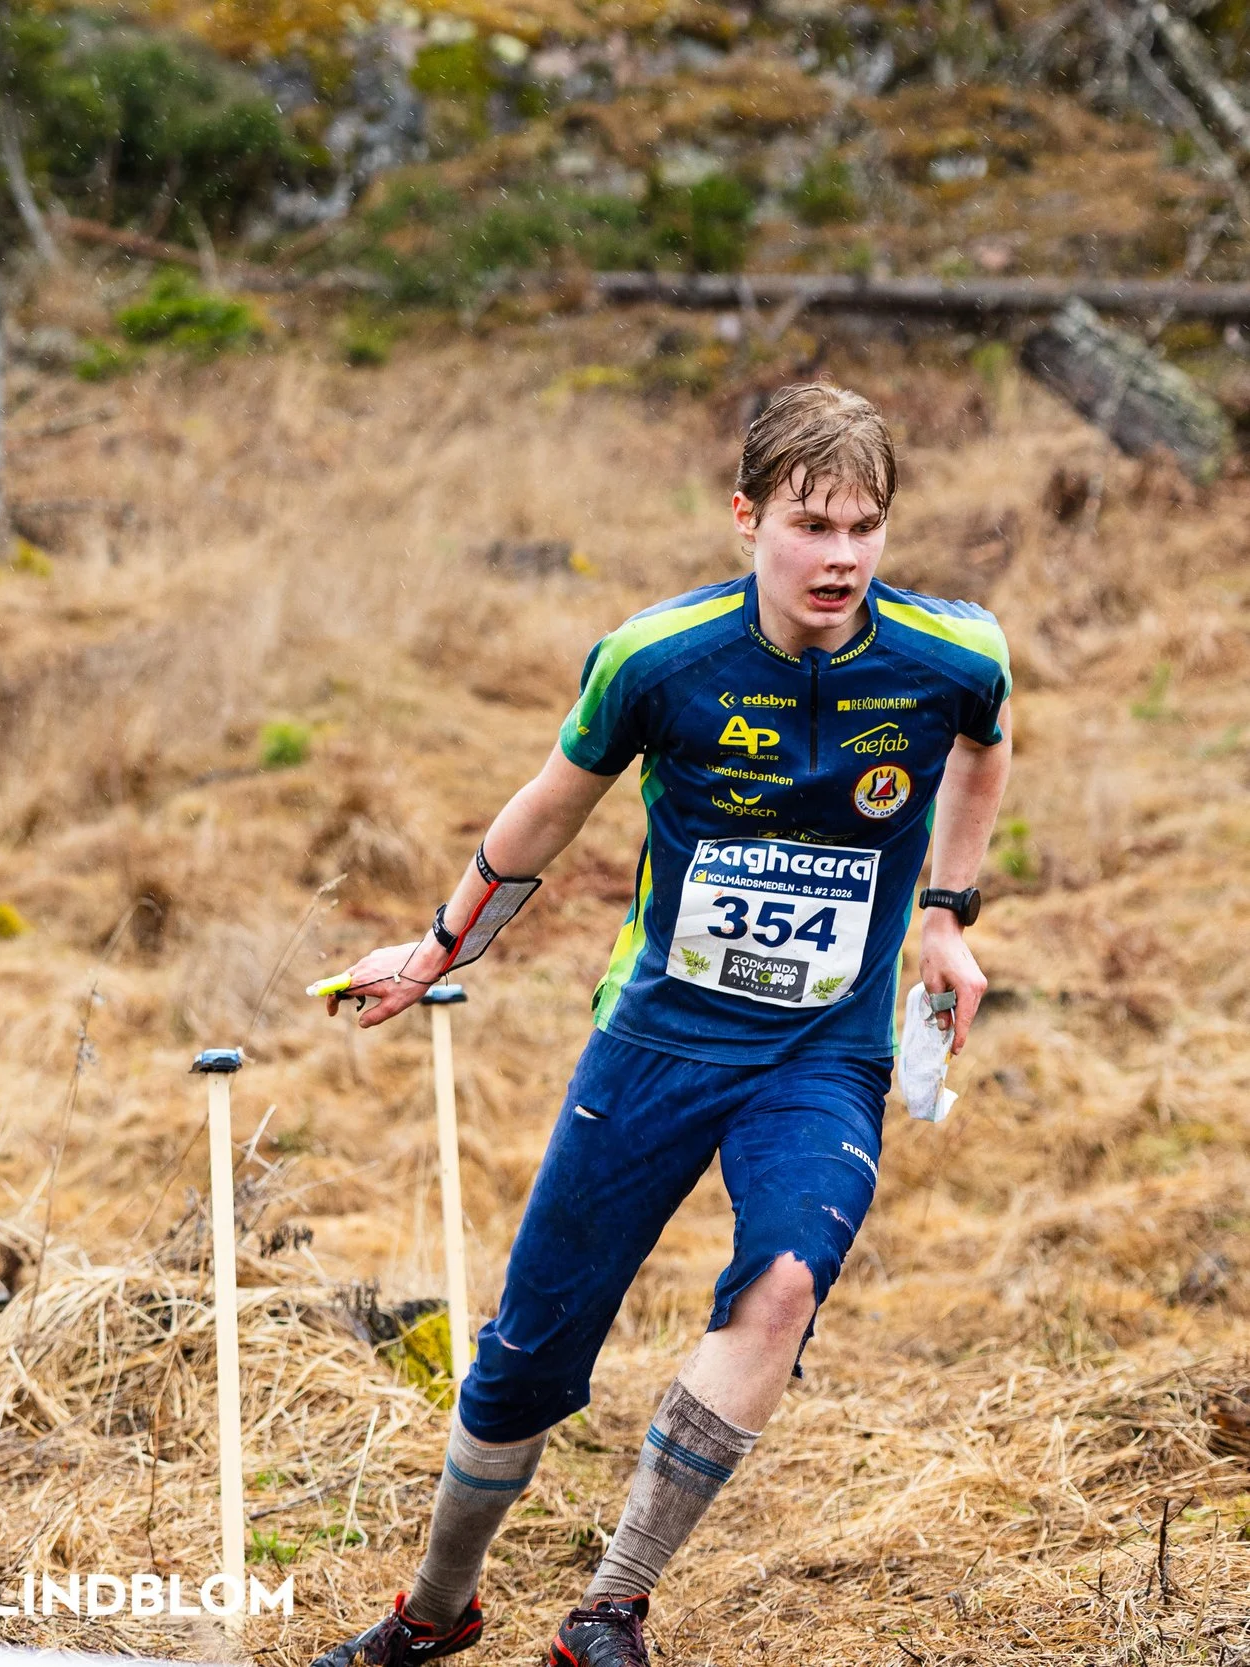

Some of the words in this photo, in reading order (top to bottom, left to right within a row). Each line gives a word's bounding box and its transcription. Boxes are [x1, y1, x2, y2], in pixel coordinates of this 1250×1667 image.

[742, 693, 797, 709] edsbyn
[718, 715, 781, 755] AP
[854, 732, 909, 757] aefab
[696, 843, 873, 881] bagheera
[707, 872, 795, 893] KOLMÅRDSMEDELN
[802, 885, 813, 895] SL
[815, 887, 828, 897] #2
[830, 889, 853, 899] 2026
[707, 895, 838, 952] 354
[731, 955, 799, 976] GODKÄNDA
[740, 981, 774, 992] SVERIGE
[777, 988, 789, 996] AB
